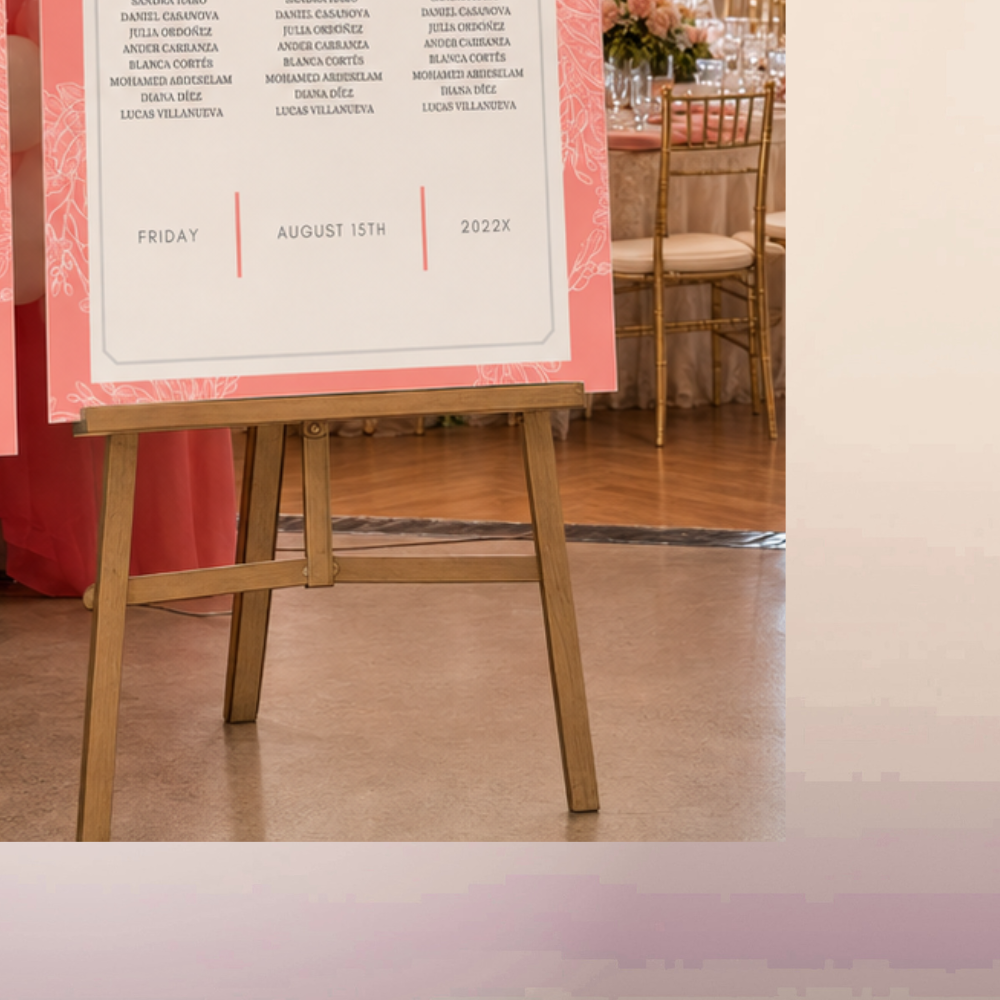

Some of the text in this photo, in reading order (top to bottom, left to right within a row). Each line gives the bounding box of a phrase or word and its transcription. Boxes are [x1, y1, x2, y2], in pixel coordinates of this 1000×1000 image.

[283, 57, 324, 66] BLANCA
[429, 54, 467, 64] BLANCA
[128, 60, 171, 70] BLANCA
[275, 105, 374, 115] LUCAS VILLANUEVA
[422, 101, 516, 112] LUCAS VILLANUEVA
[120, 108, 223, 119] LUCAS VILLANUEVA
[278, 223, 385, 239] AUGUST 15TH
[461, 219, 510, 233] 2022X
[138, 229, 198, 243] FRIDAY
